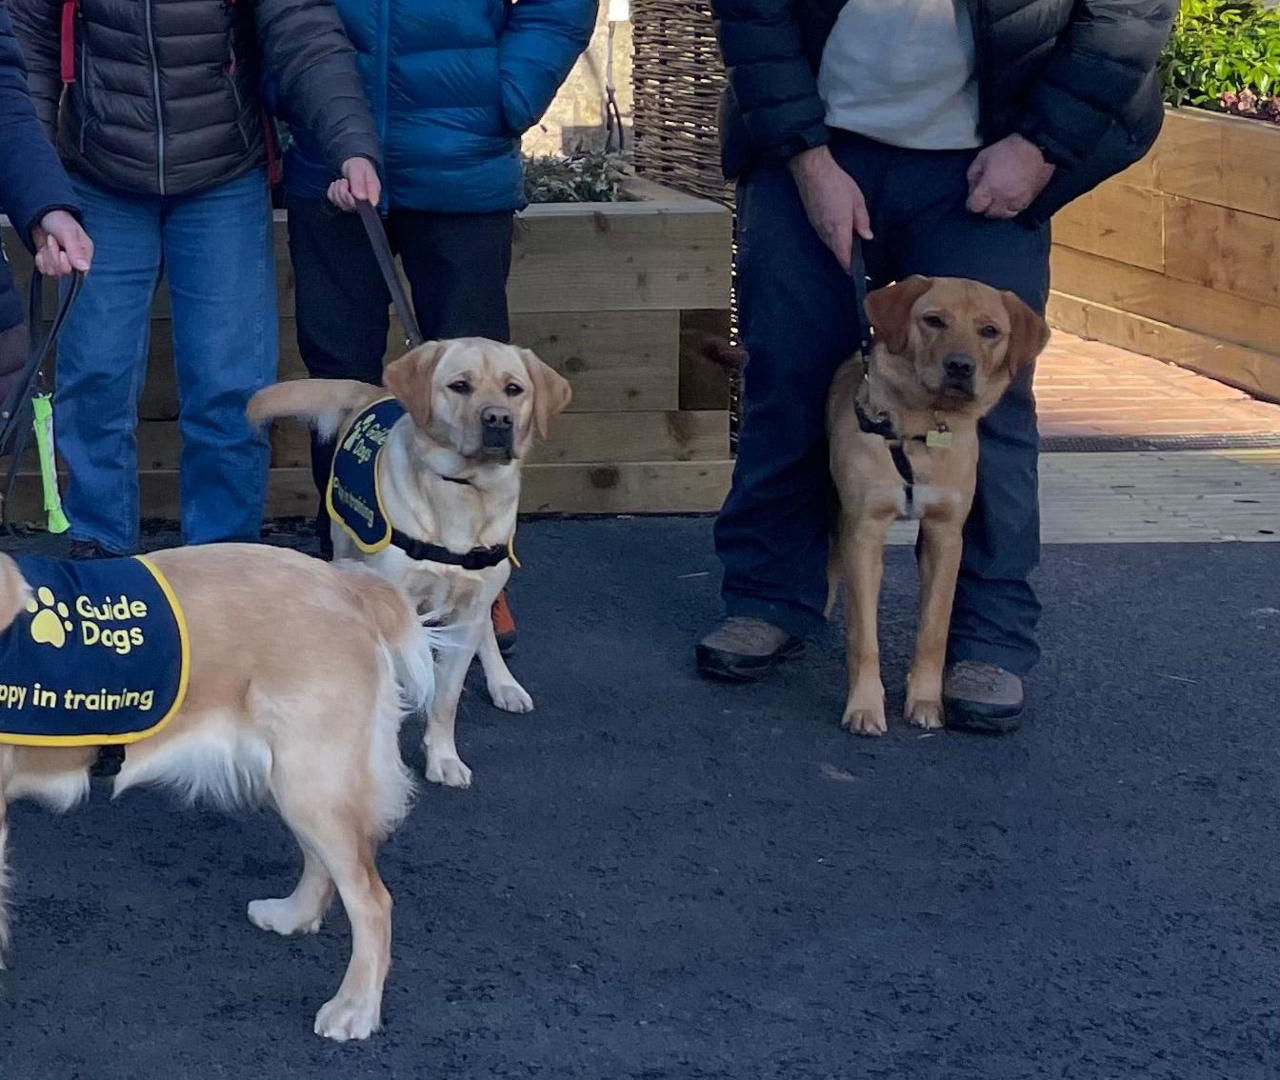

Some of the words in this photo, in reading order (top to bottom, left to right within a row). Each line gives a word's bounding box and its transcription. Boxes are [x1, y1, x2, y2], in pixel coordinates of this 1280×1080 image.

[75, 594, 148, 621] Guide
[81, 620, 145, 655] Dogs
[32, 683, 57, 709] in
[63, 687, 155, 711] training
